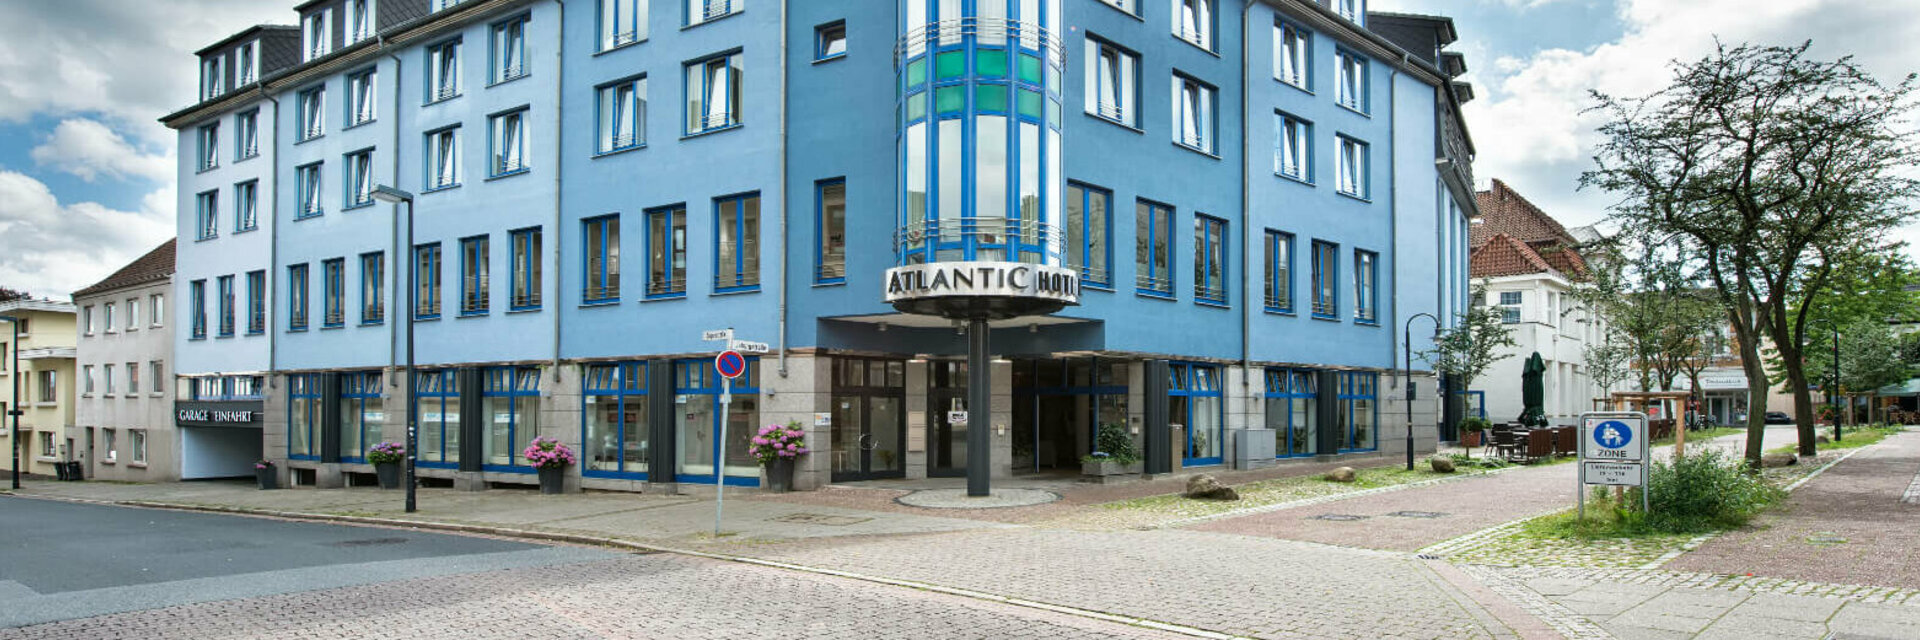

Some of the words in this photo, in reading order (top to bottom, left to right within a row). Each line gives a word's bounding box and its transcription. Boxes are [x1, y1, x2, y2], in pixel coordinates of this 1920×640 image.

[888, 267, 1029, 294] ATLANTIC
[179, 409, 208, 421] GARAGE
[214, 410, 251, 422] EINFAHRT
[1597, 449, 1627, 458] ZONE
